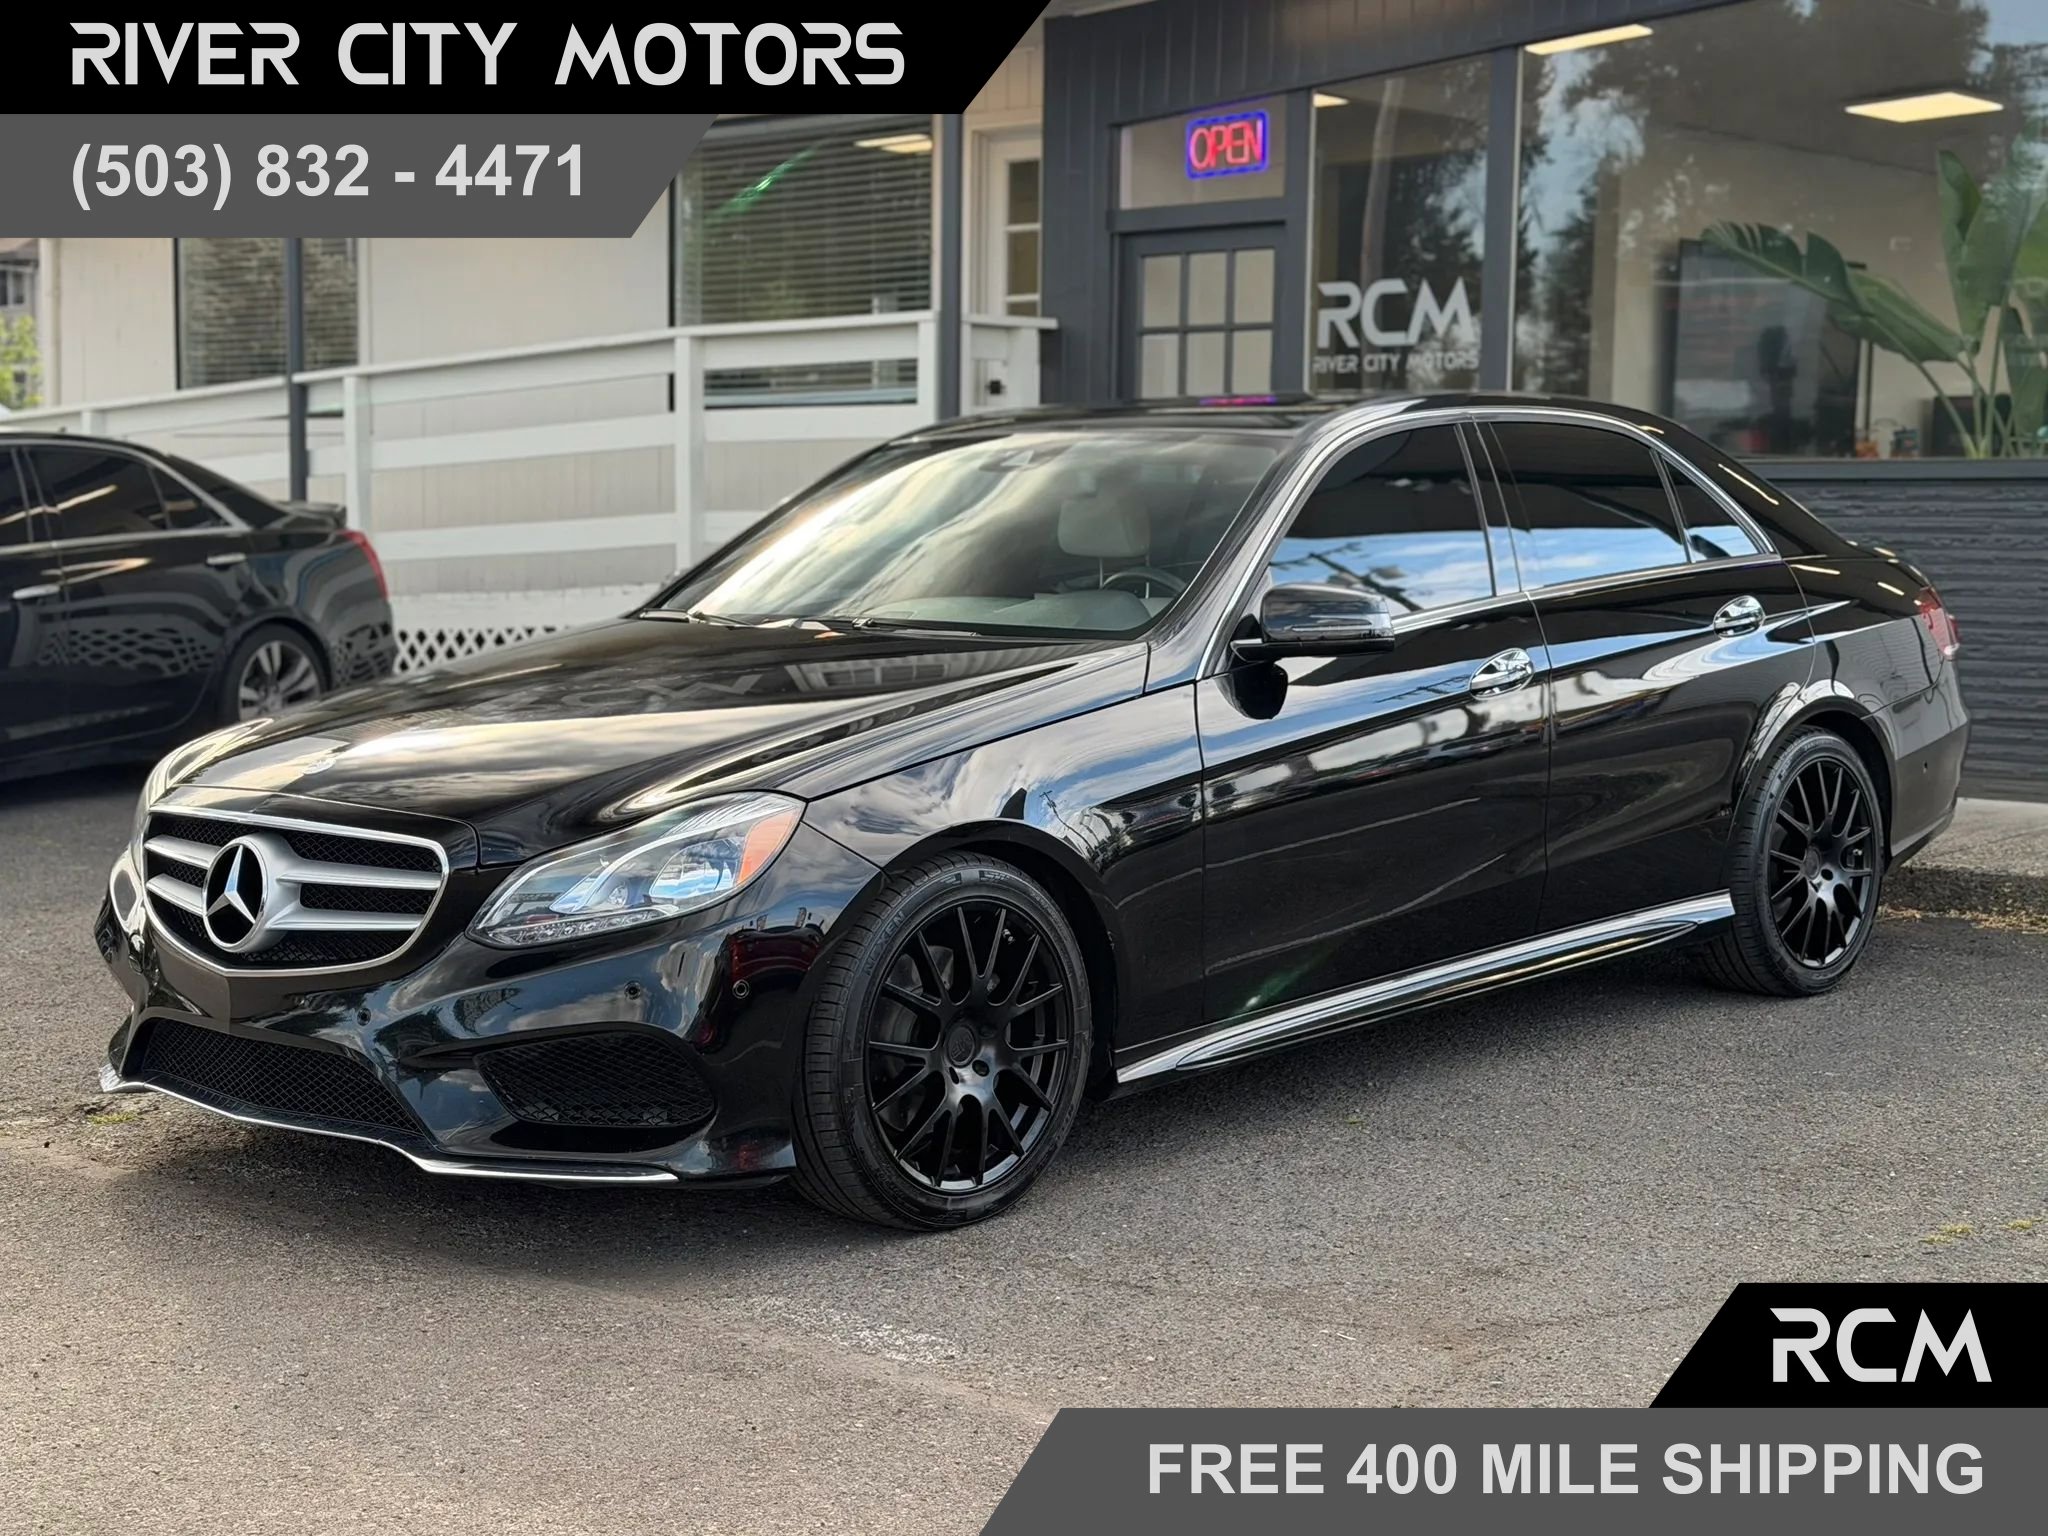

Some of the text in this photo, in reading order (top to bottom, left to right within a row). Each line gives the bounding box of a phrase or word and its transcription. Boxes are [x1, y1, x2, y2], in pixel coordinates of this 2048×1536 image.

[1189, 119, 1264, 171] OPEN
[1317, 276, 1476, 348] RCM
[1312, 350, 1480, 374] RIVER CITY MOTORS
